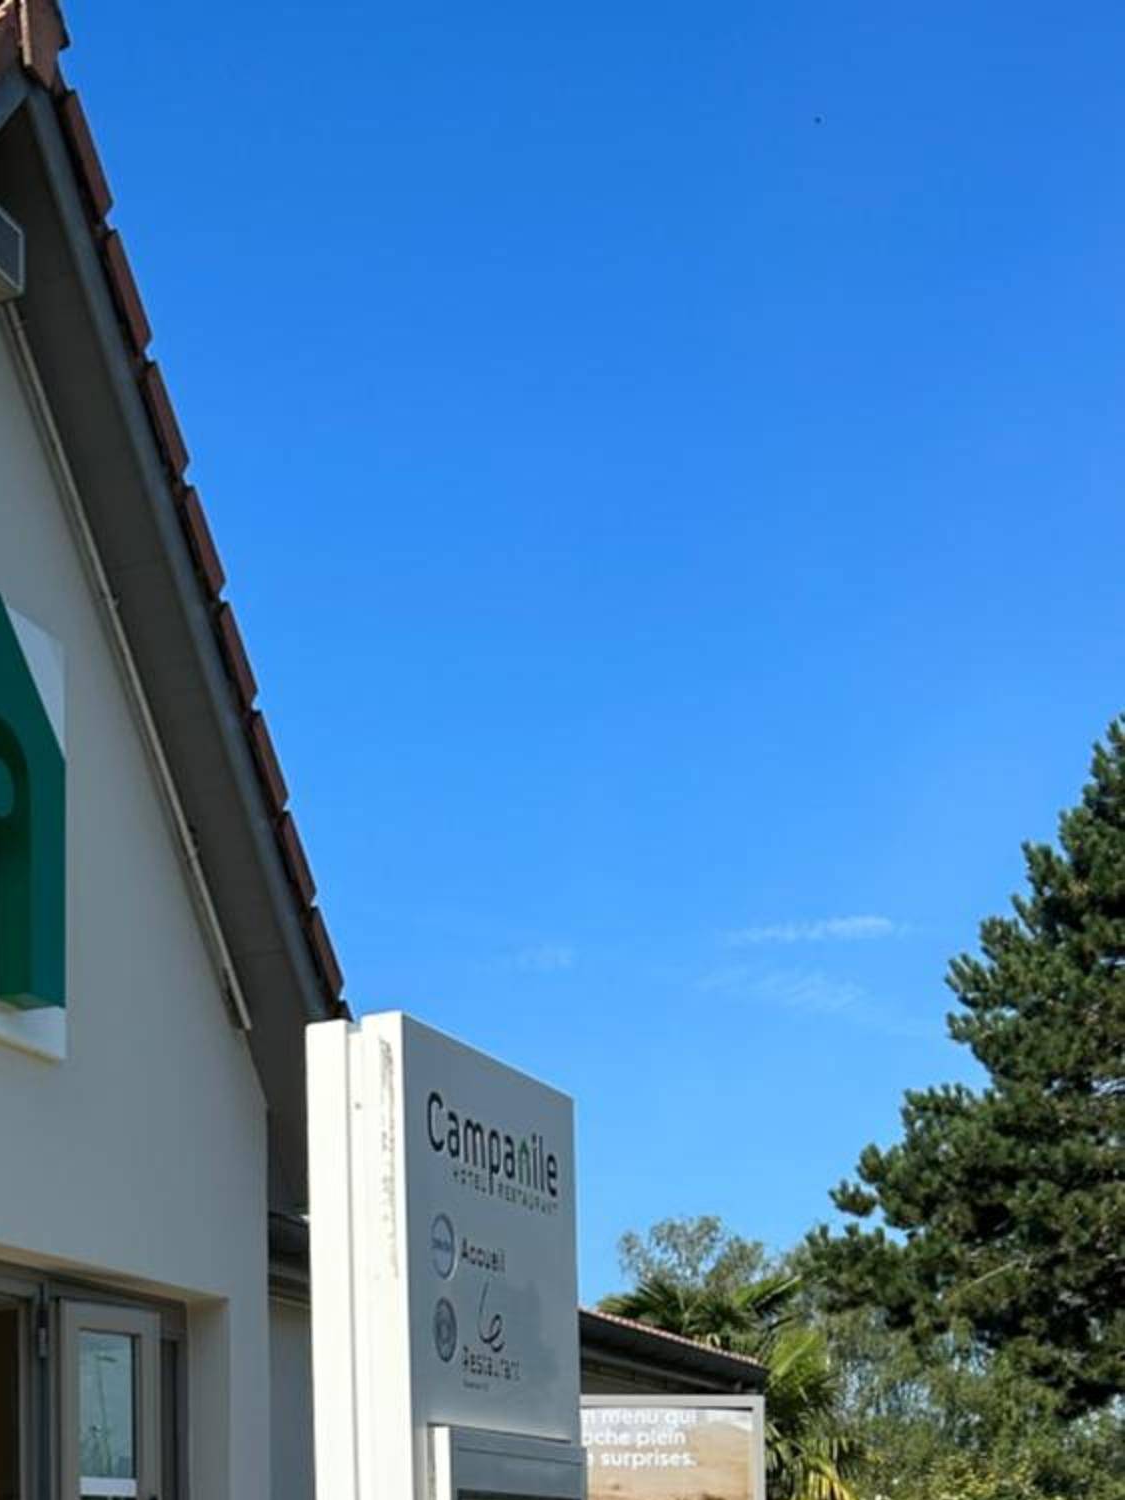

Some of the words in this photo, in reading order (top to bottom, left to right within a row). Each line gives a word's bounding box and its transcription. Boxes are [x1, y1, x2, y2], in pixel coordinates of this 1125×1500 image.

[427, 1091, 558, 1197] Campanile
[461, 1238, 506, 1272] Accueil
[602, 1408, 659, 1425] menu
[665, 1409, 698, 1430] qui
[581, 1426, 631, 1446] ache
[636, 1427, 687, 1450] plein
[601, 1447, 698, 1471] surprises.
